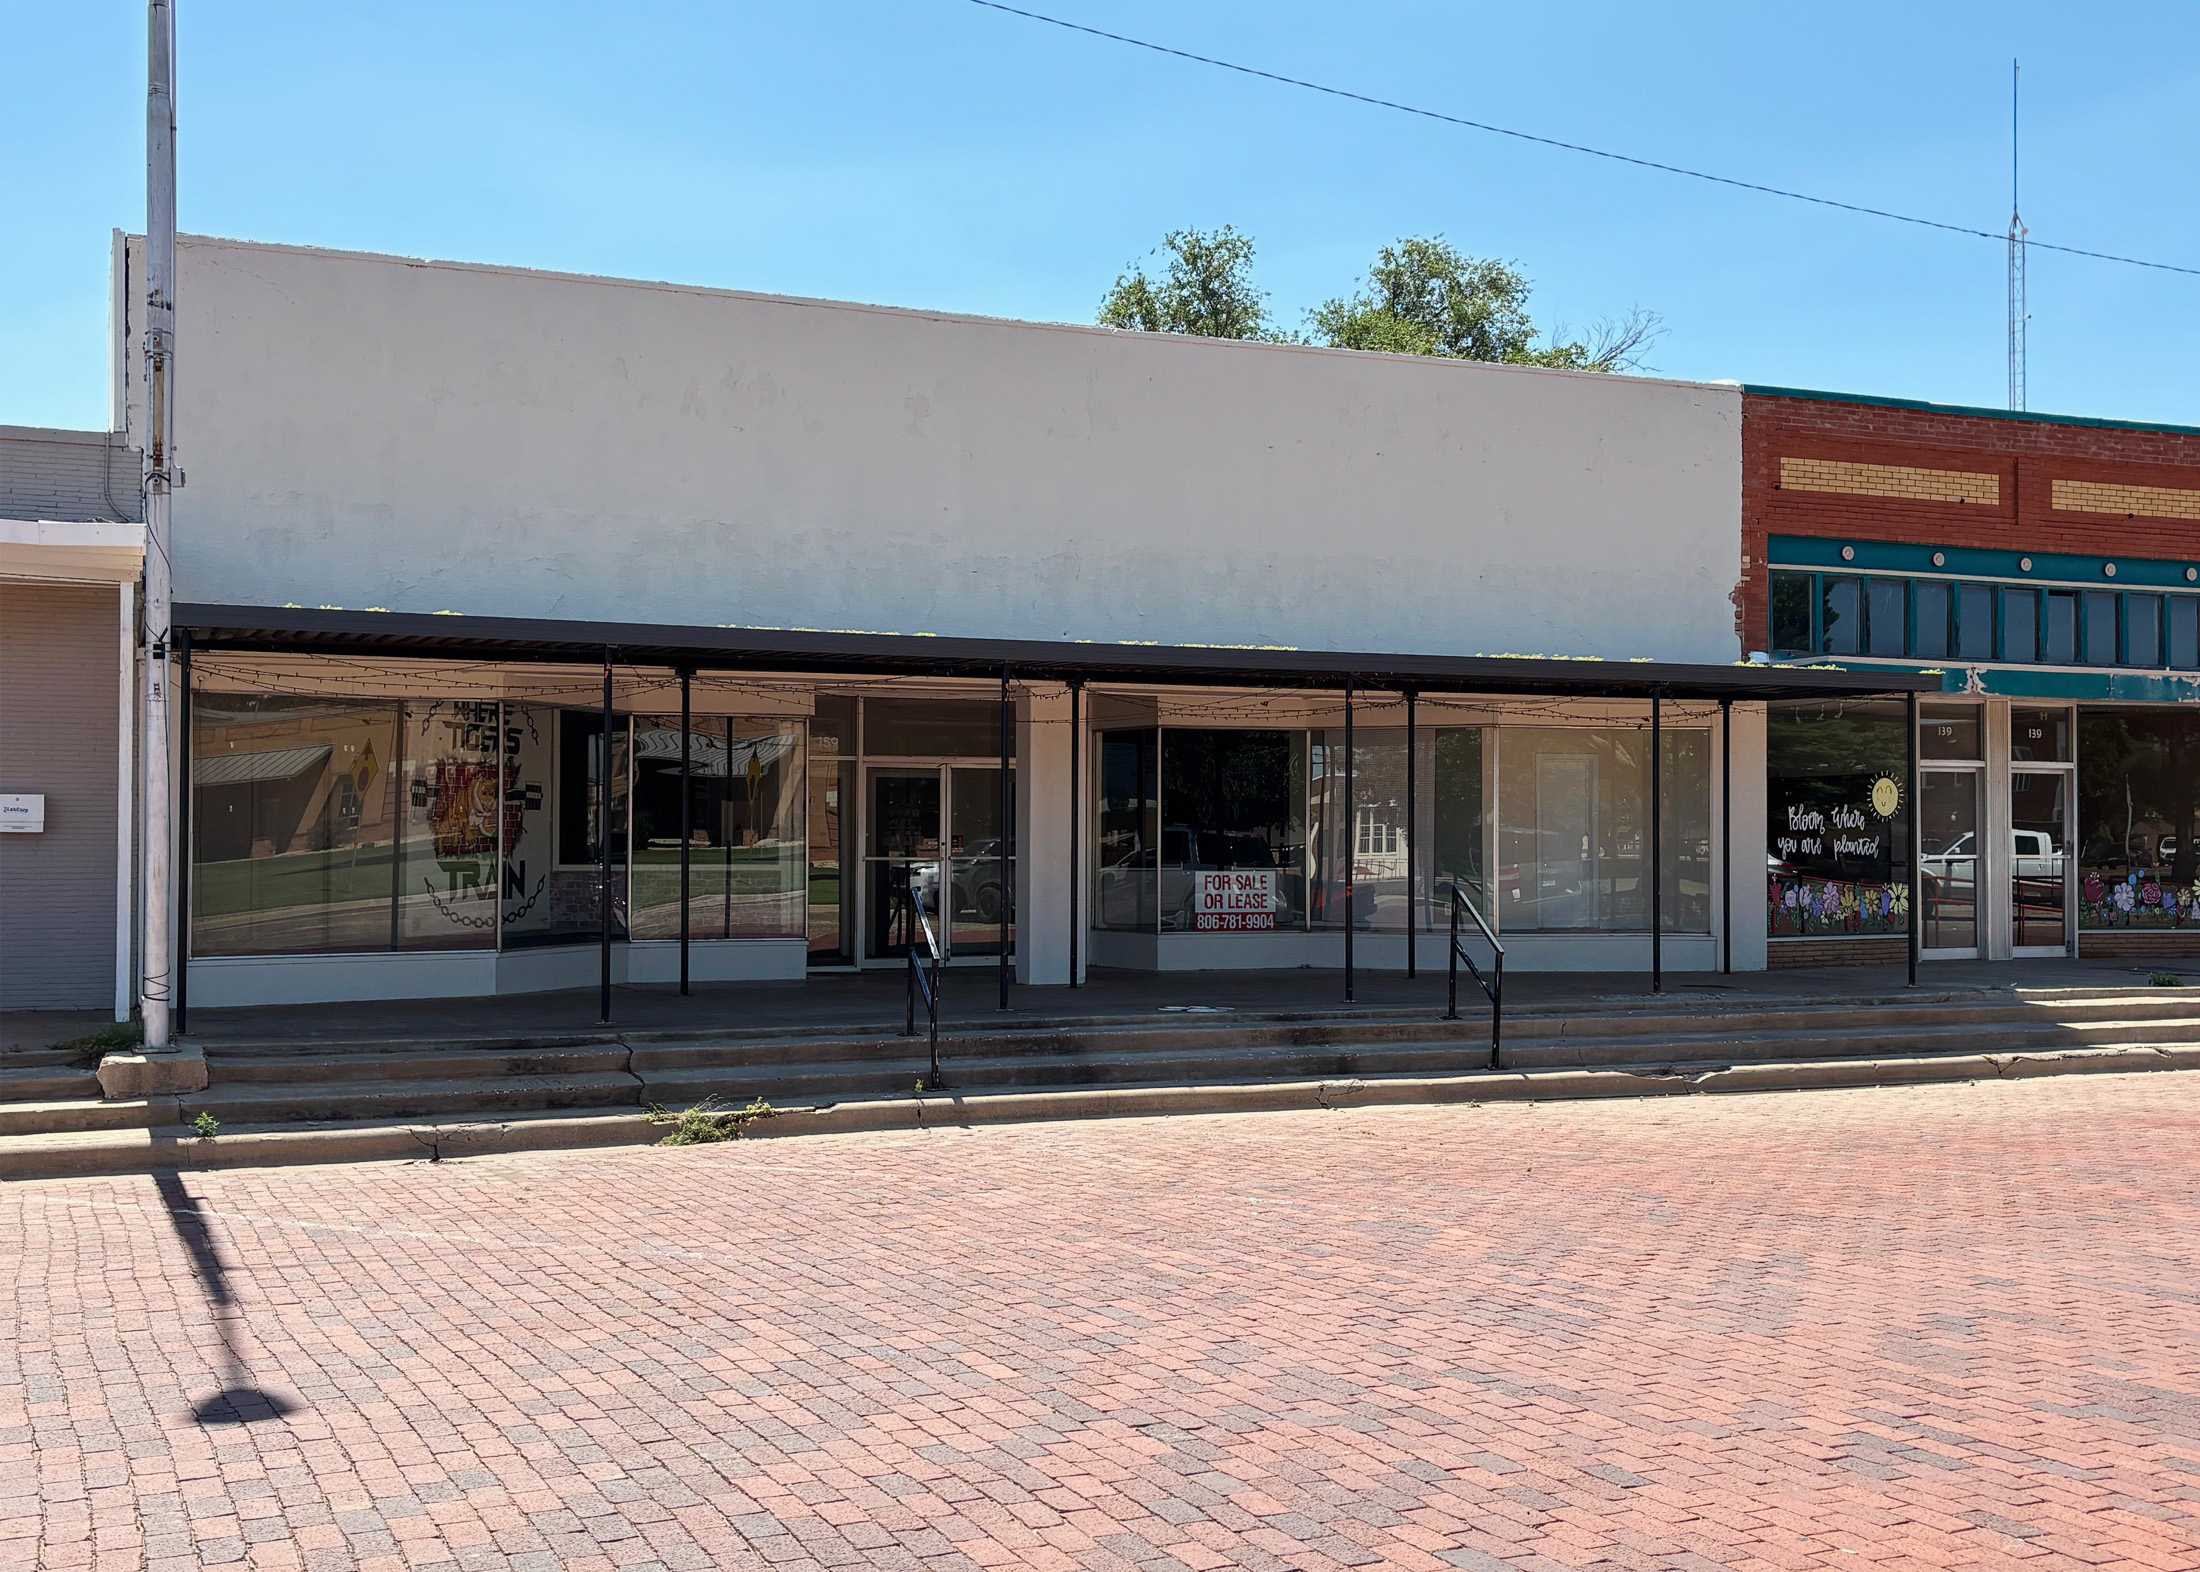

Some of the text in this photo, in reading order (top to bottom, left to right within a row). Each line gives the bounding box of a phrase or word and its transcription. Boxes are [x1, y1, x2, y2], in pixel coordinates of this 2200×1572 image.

[1938, 726, 1953, 736] 139
[2028, 728, 2043, 739] 139
[819, 736, 839, 748] 159
[1788, 803, 1826, 835] Bloom
[1777, 834, 1880, 861] you are planted
[437, 860, 526, 903] TRAIN
[1204, 874, 1268, 891] FOR SALE
[1204, 893, 1268, 909] OR LEASE
[1197, 914, 1275, 930] 806-781-9904
